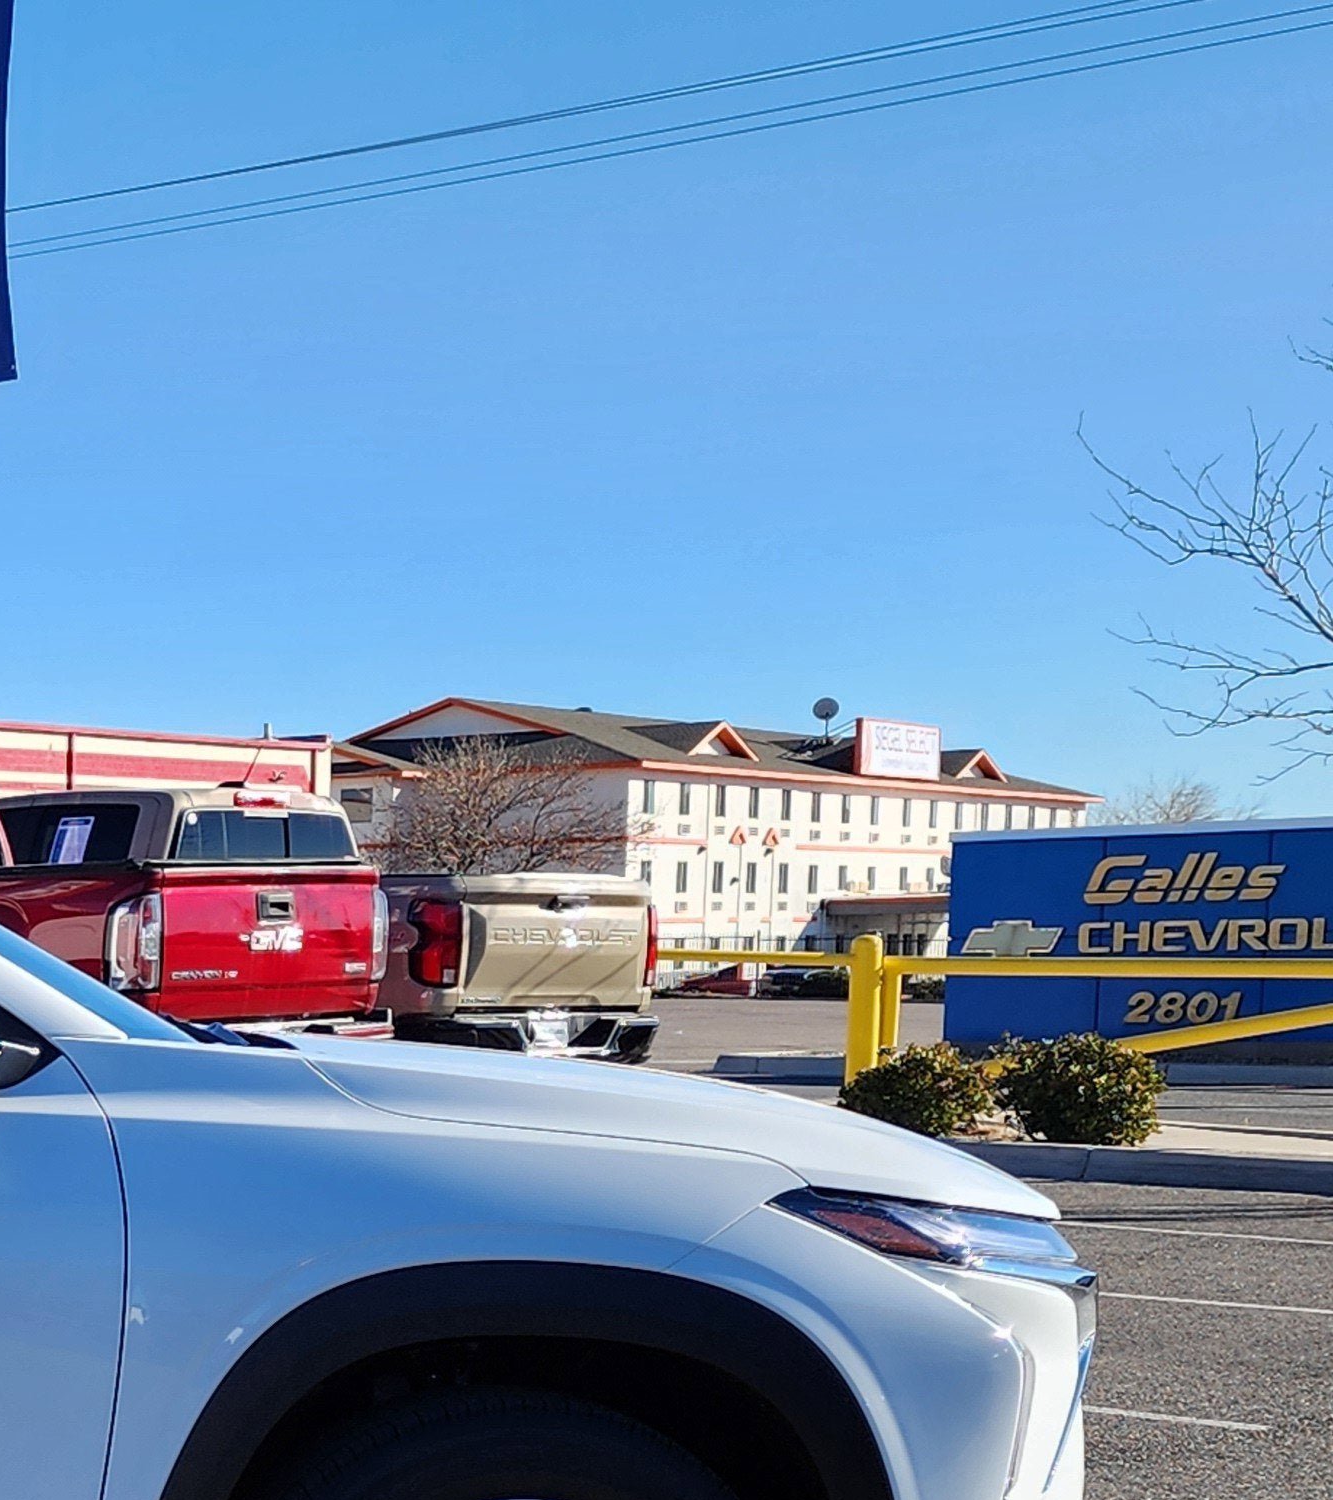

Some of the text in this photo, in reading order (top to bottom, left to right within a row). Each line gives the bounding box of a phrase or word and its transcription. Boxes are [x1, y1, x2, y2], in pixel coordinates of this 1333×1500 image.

[1083, 852, 1286, 905] Galles
[489, 927, 638, 946] CHEVOLET
[1077, 917, 1333, 954] CHEVROL
[1124, 991, 1242, 1025] 2801
